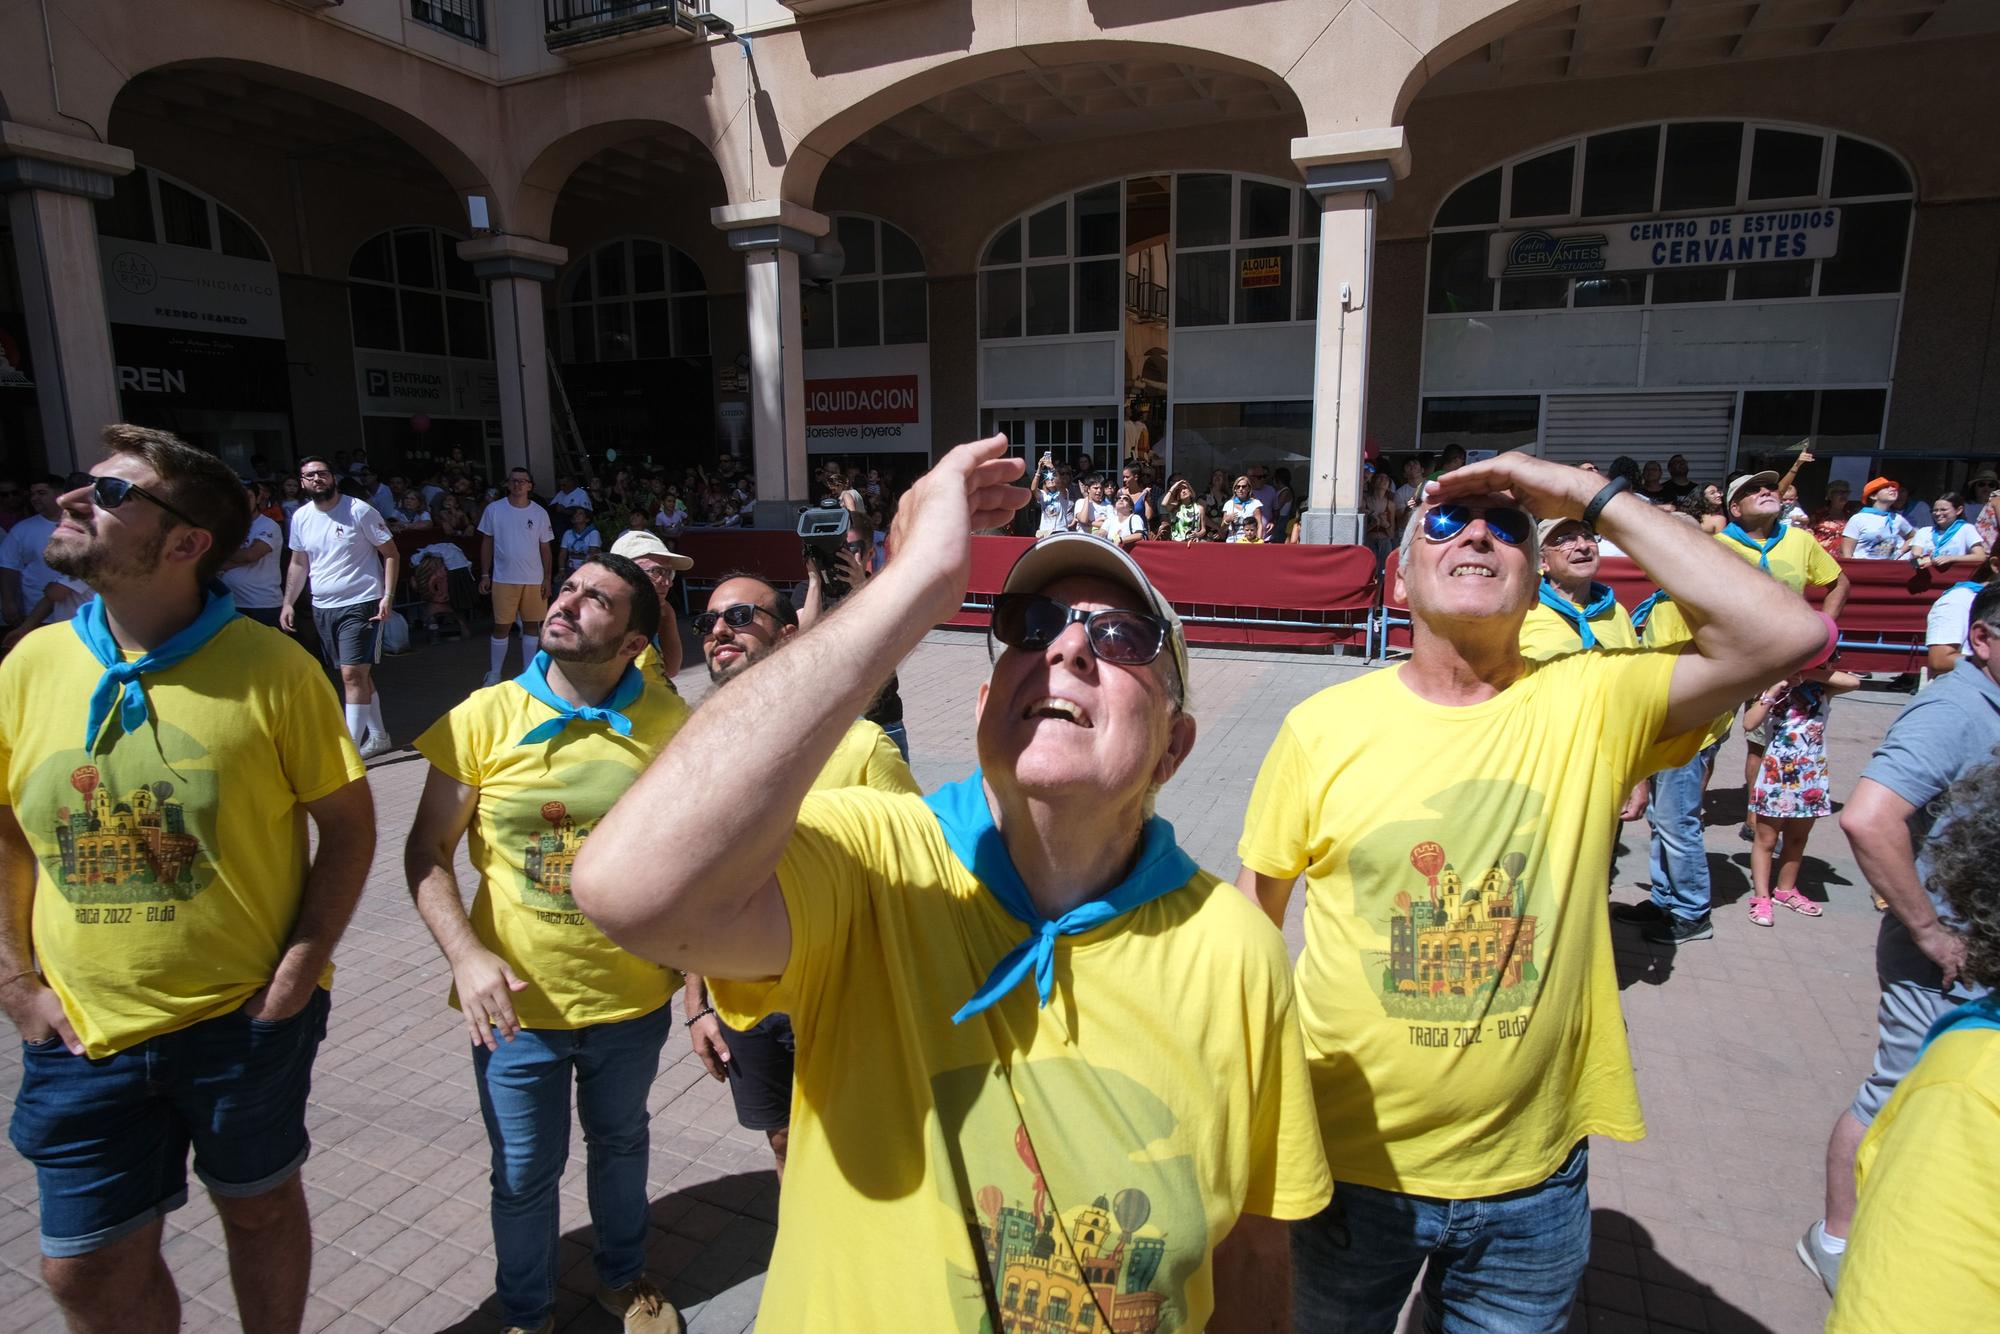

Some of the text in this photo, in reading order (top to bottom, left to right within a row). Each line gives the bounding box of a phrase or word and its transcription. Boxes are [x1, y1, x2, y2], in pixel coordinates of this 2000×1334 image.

[1630, 210, 1836, 241] CENTRO DE ESTUDIOS
[1518, 247, 1599, 264] CERVANTES
[1651, 232, 1808, 265] CERVANTES
[1242, 257, 1280, 272] ALQUILA
[391, 371, 442, 385] ENTRADA
[393, 385, 440, 399] PARKING
[861, 424, 902, 439] joyeros
[103, 907, 132, 924] 2022
[565, 913, 584, 925] 2022
[1454, 1026, 1482, 1047] 2022
